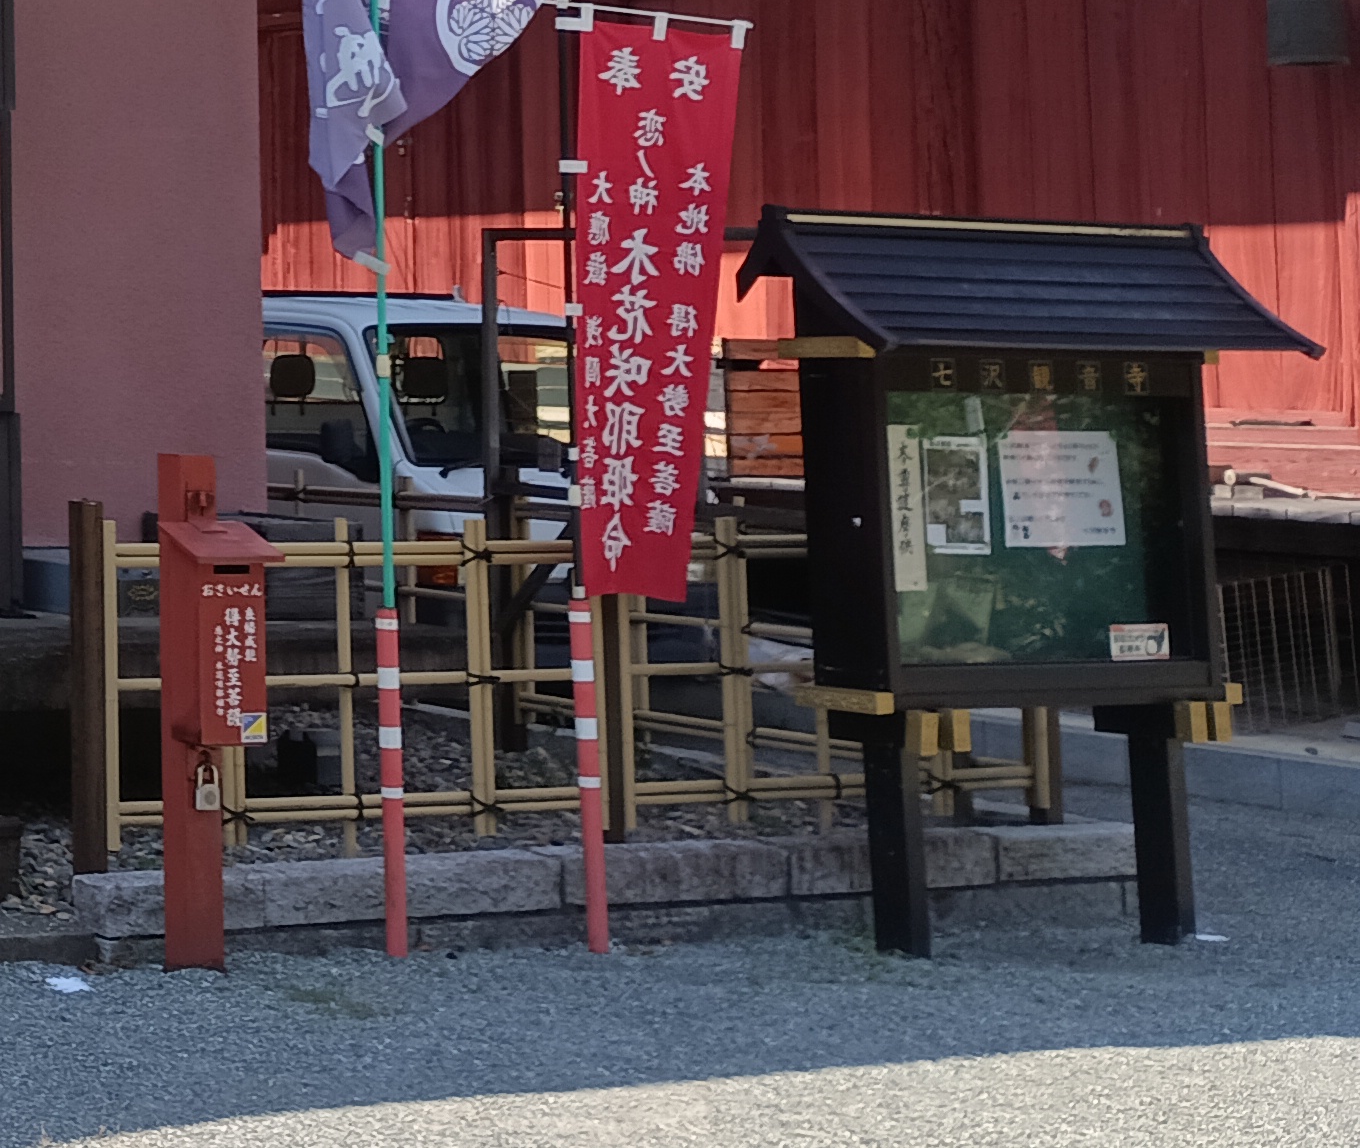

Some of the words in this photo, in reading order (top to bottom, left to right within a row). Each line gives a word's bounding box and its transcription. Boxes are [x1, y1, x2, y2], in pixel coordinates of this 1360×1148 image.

[202, 584, 262, 596] おさいせん
